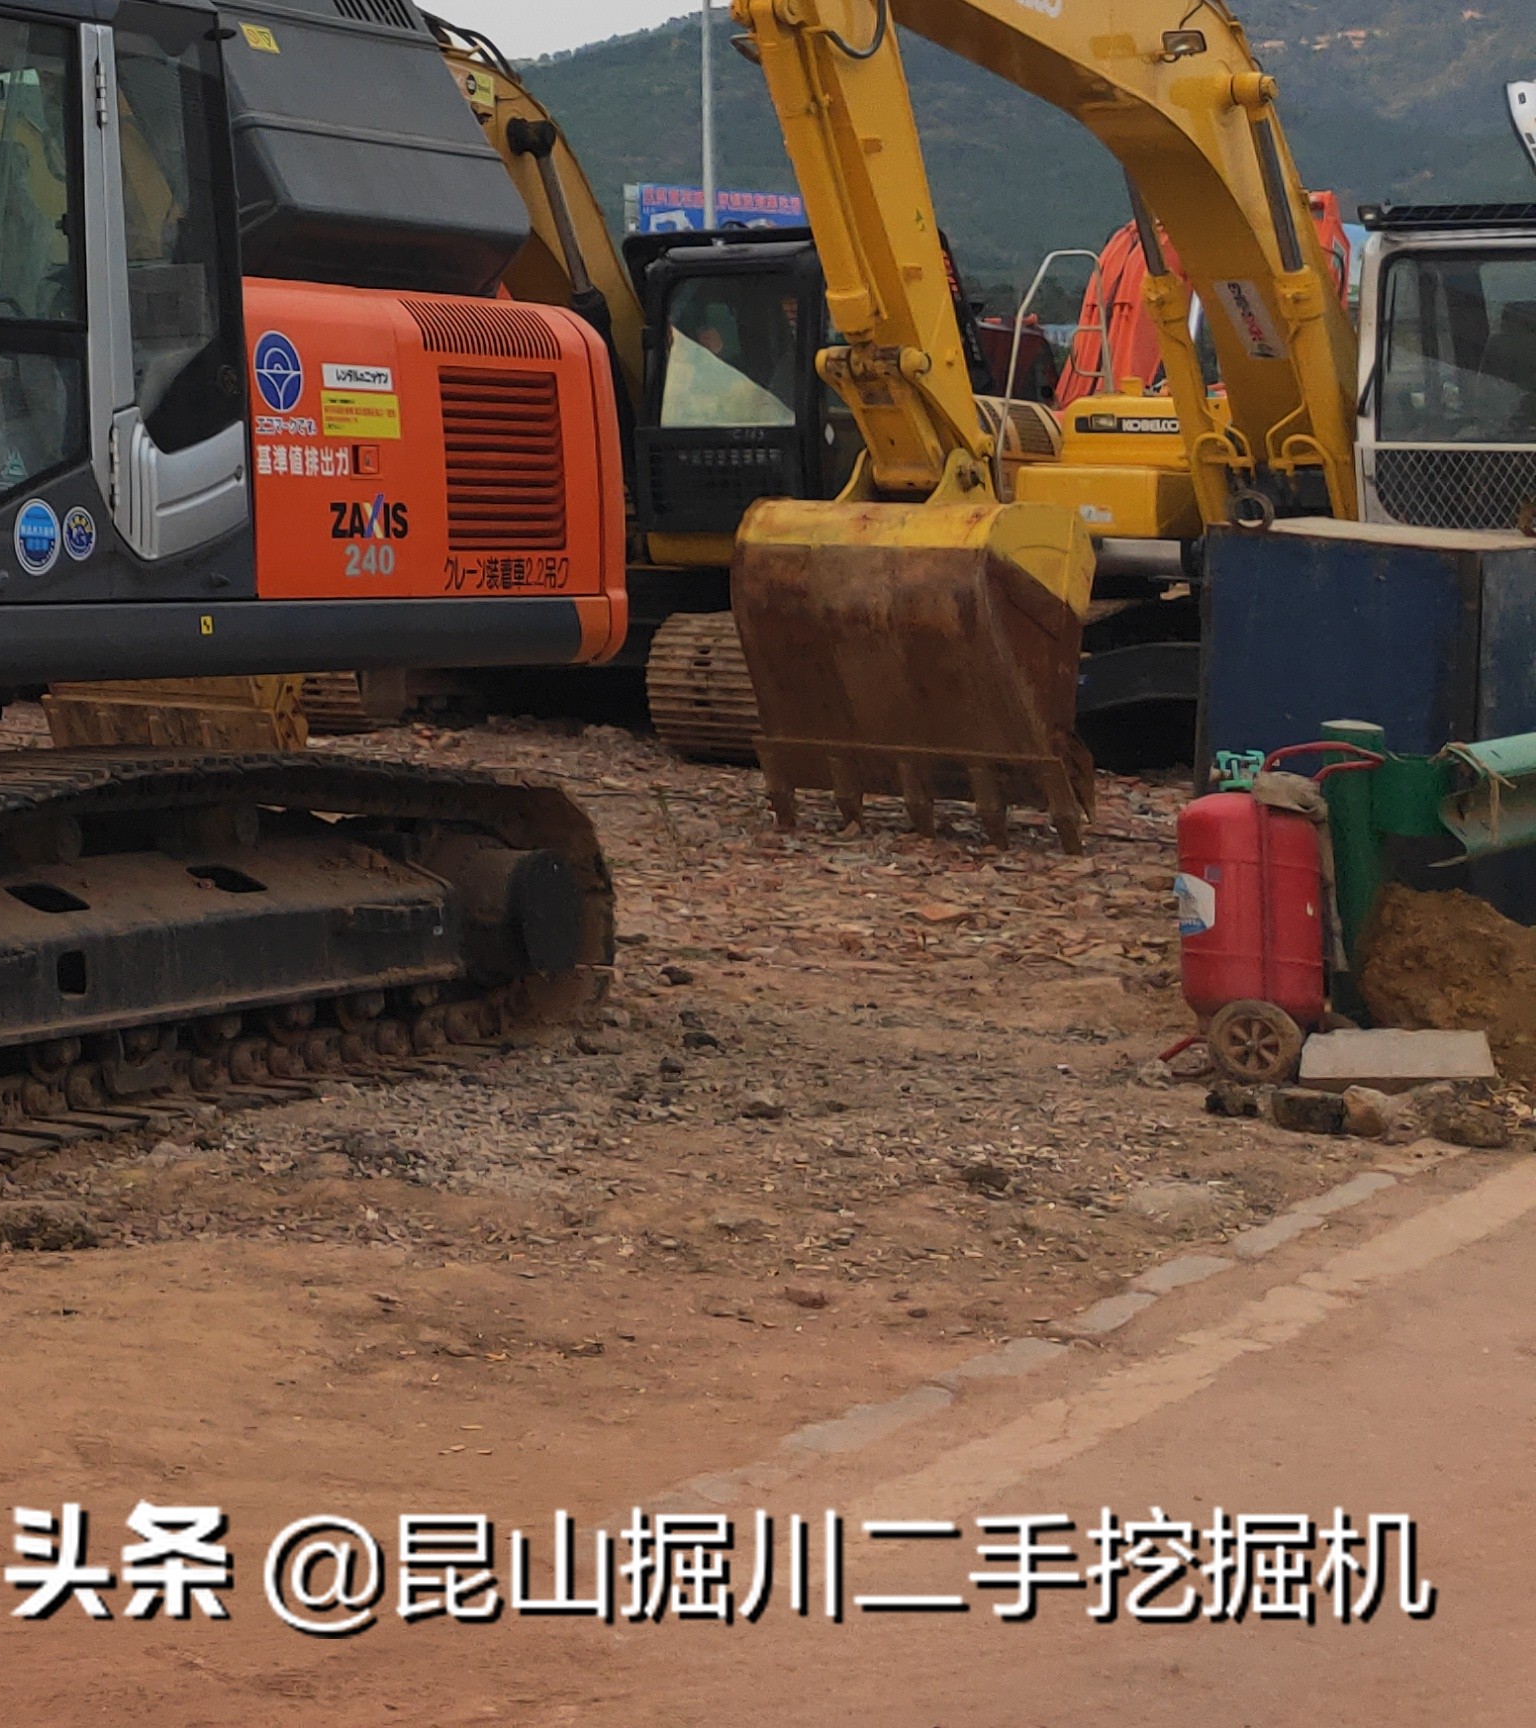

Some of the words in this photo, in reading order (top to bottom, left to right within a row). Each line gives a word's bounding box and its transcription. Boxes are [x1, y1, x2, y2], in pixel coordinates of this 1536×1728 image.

[1121, 418, 1180, 432] KOBELCO
[329, 494, 409, 539] ZAXIS
[344, 544, 395, 577] 240
